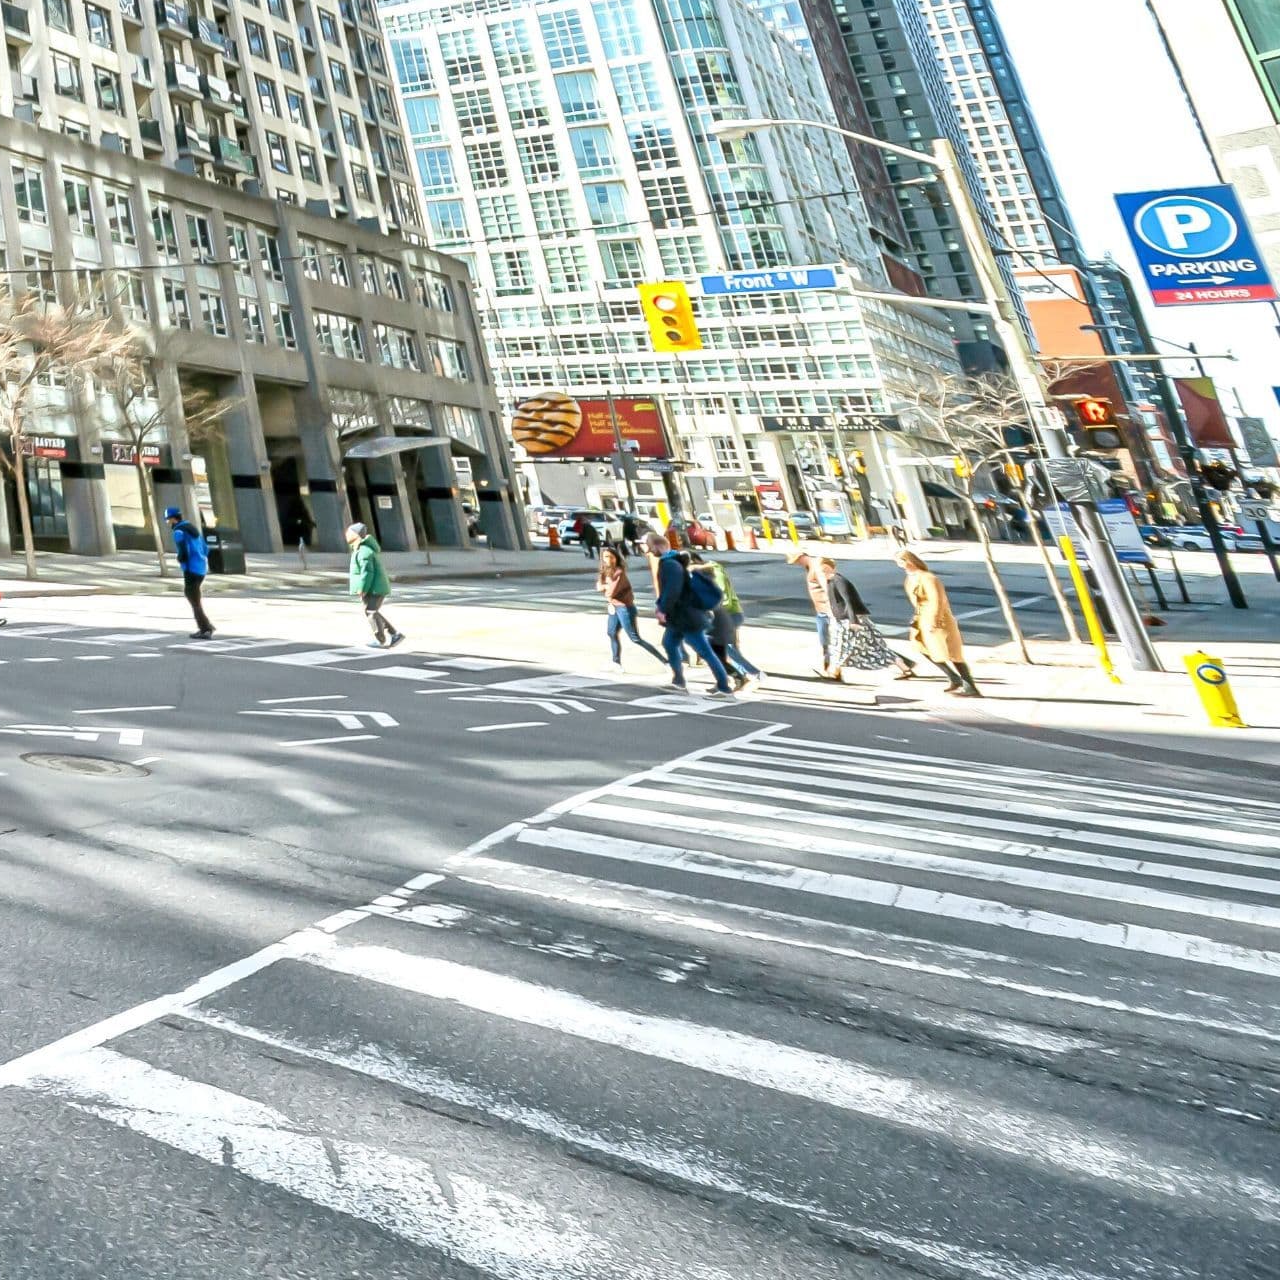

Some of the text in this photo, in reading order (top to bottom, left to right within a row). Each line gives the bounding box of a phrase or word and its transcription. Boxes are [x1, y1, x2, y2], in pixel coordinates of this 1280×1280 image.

[1148, 258, 1258, 277] PARKING
[723, 273, 775, 290] Front
[790, 270, 808, 286] W
[1174, 288, 1251, 300] 24 HOURS
